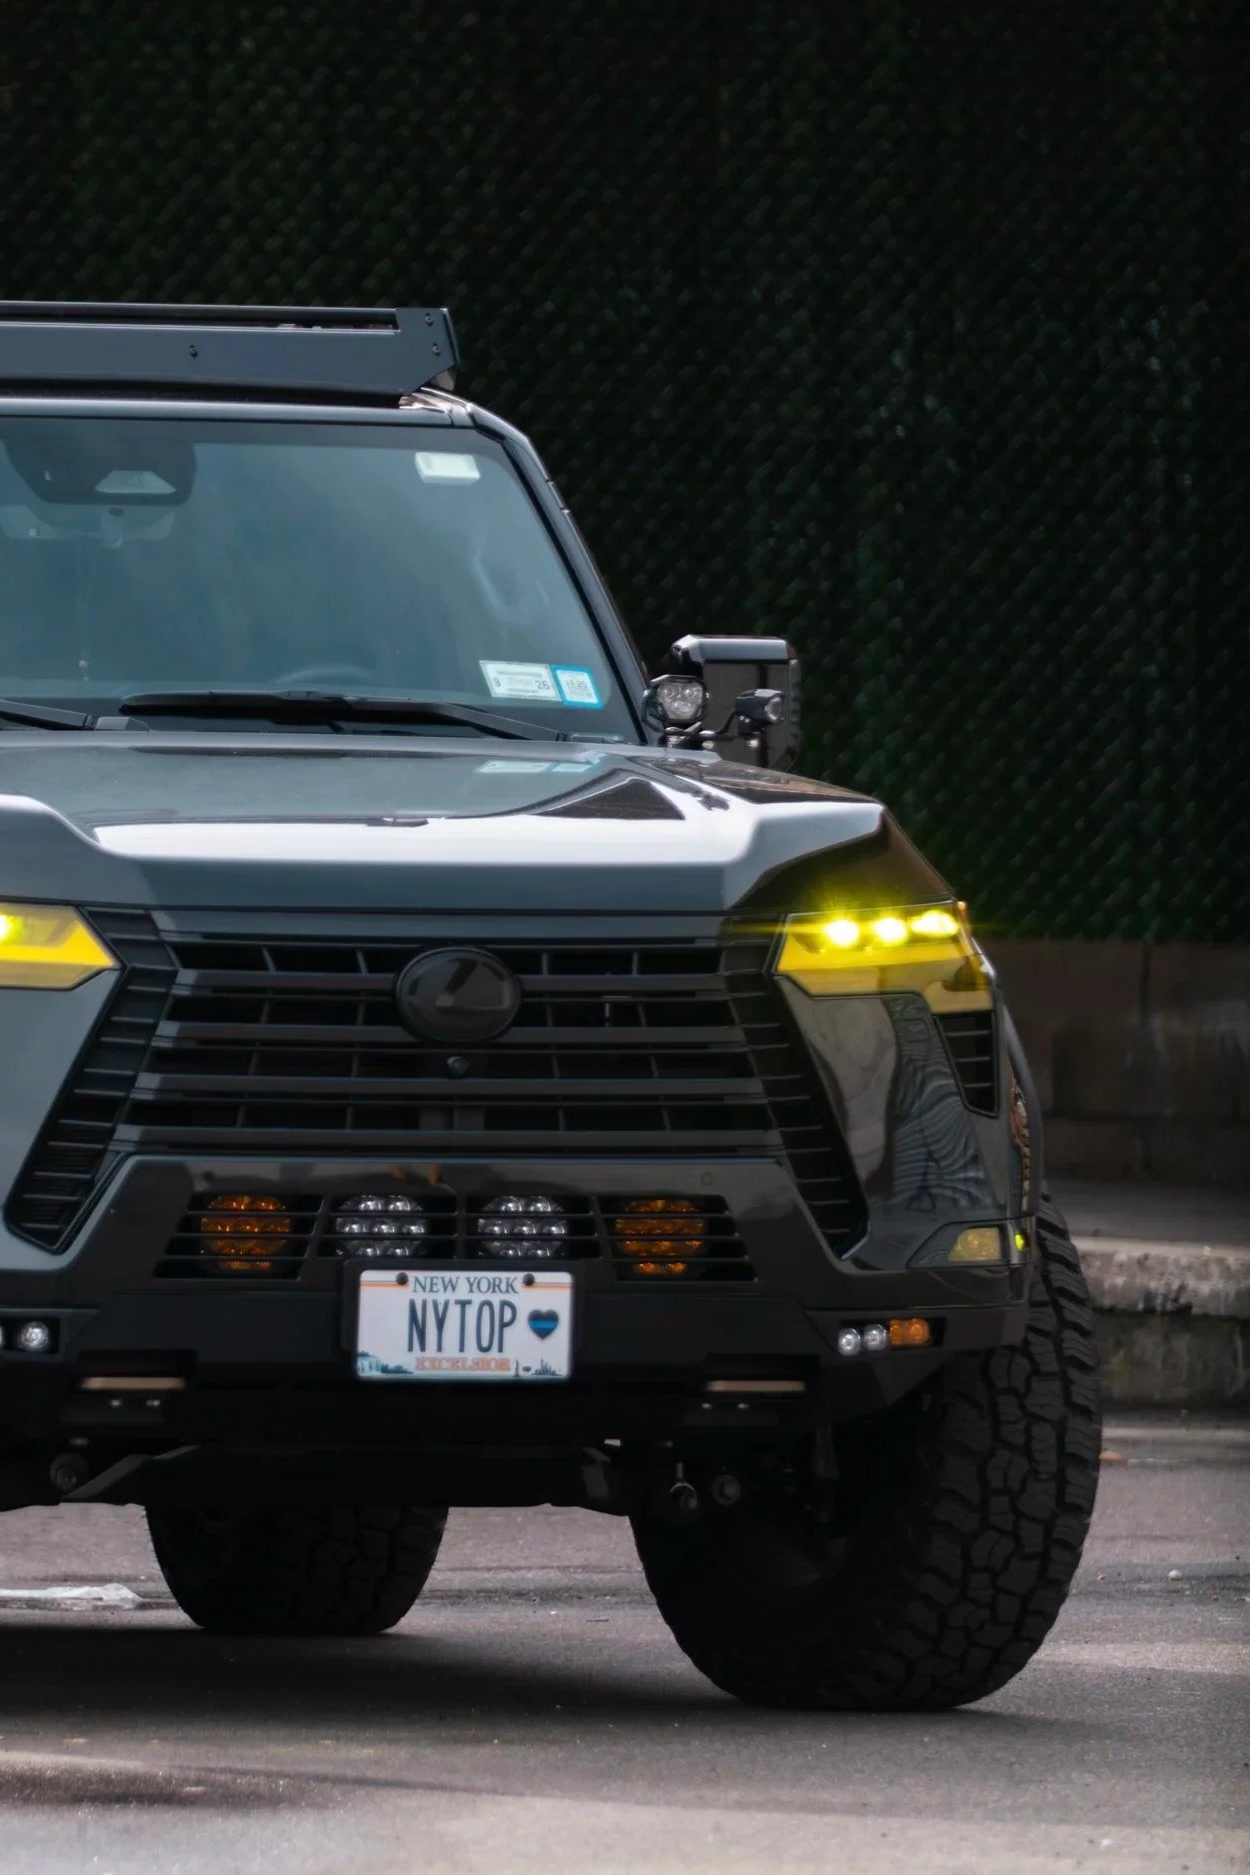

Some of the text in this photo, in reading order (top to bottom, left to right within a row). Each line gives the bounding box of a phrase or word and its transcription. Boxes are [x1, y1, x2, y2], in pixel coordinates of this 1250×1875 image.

[412, 1276, 519, 1294] NEW YORK
[407, 1298, 518, 1353] NYTOP
